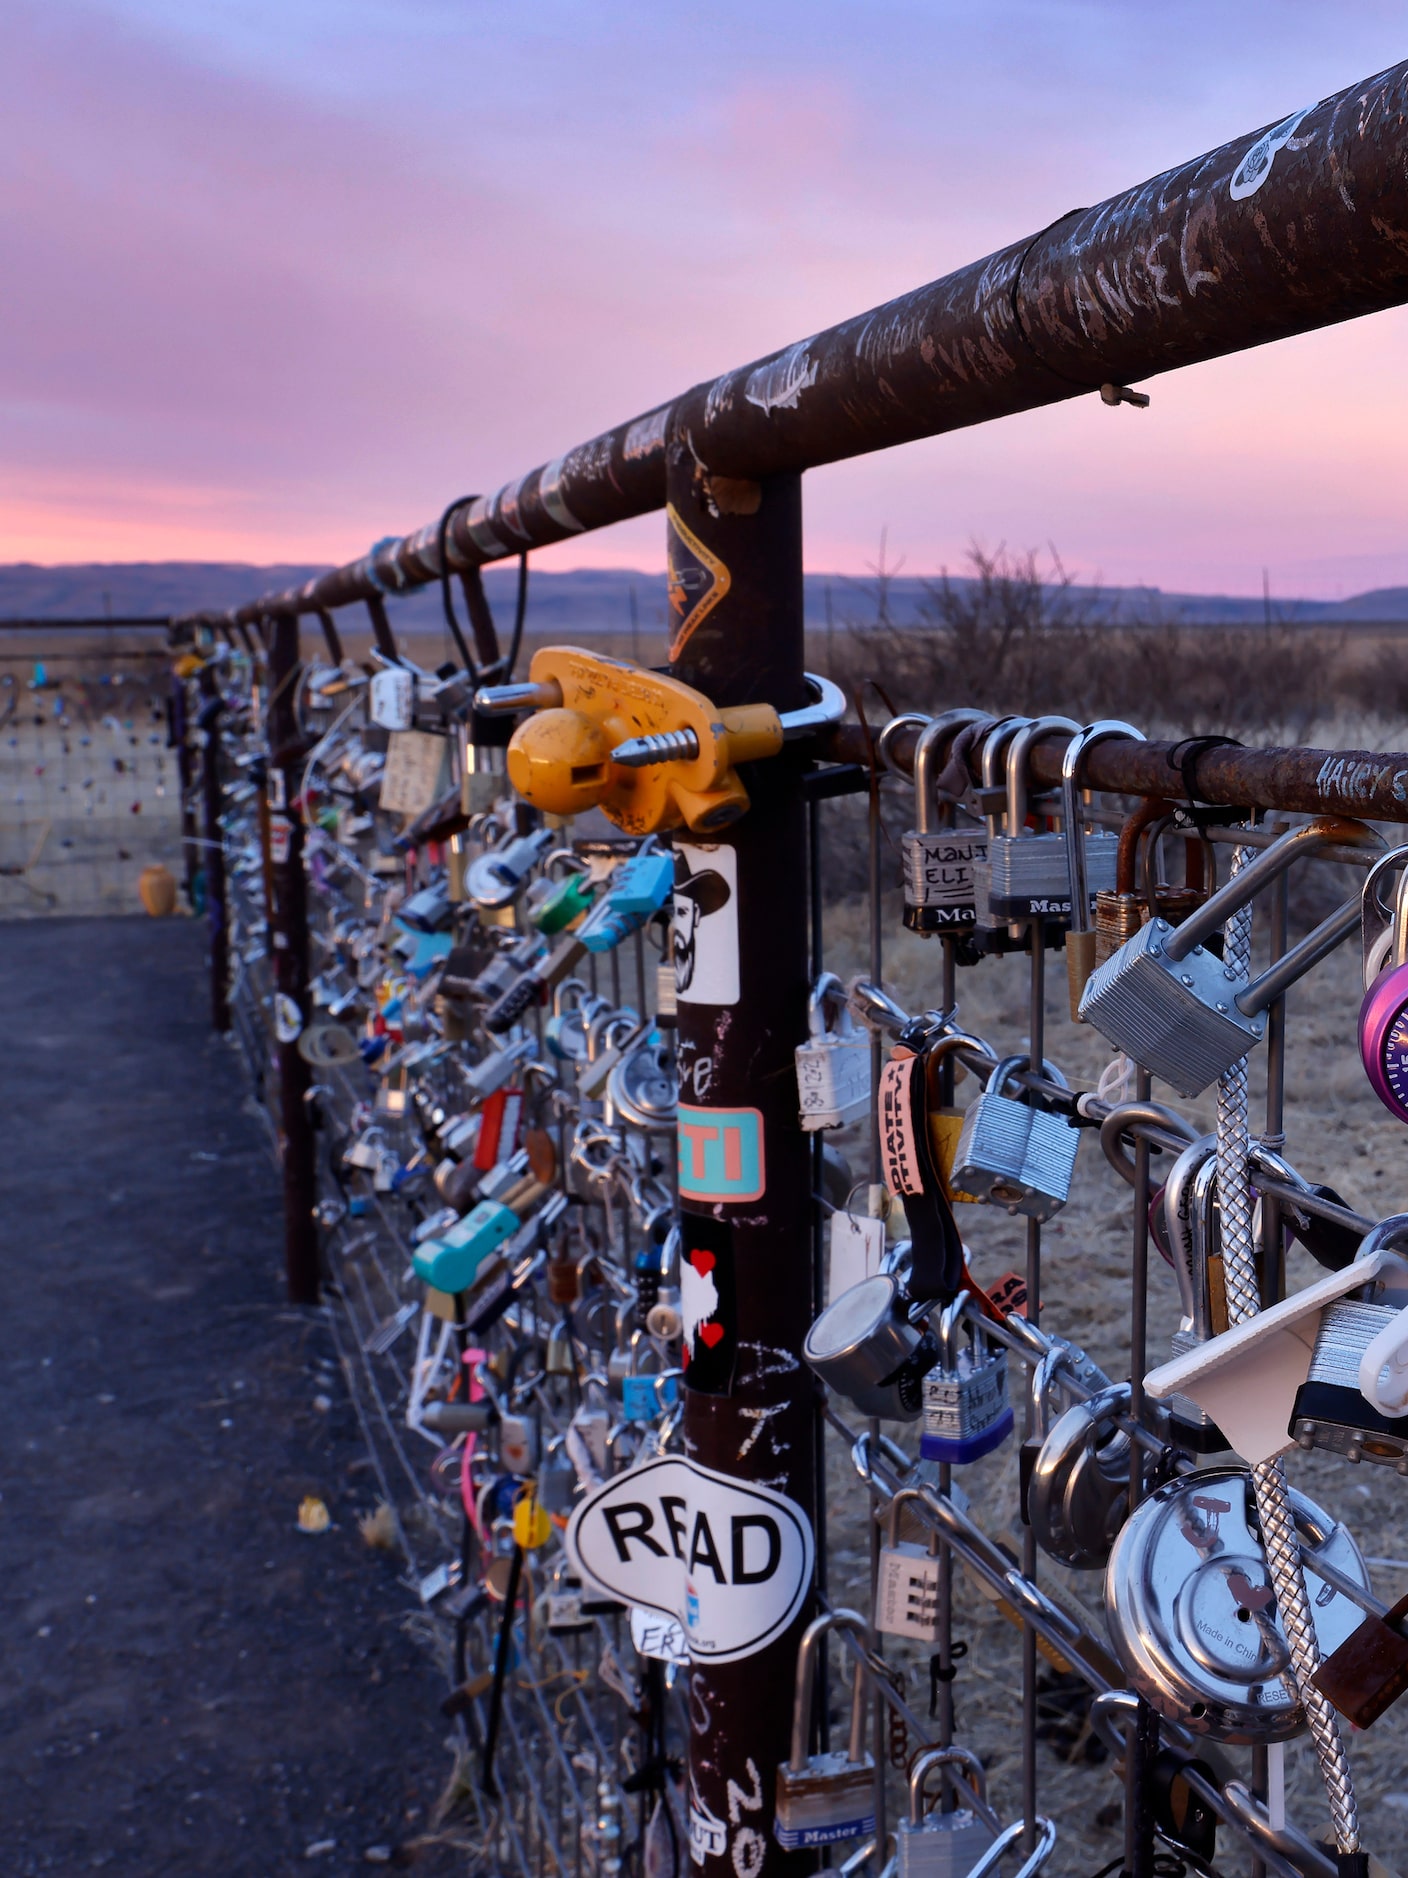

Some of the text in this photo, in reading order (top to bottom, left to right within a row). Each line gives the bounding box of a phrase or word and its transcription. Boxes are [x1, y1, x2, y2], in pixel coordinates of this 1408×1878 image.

[1029, 899, 1097, 913] Masr
[678, 1122, 743, 1181] TI
[884, 1090, 904, 1191] DIATE
[602, 1495, 782, 1587] READ
[1197, 1620, 1258, 1662] Made in Chin
[1257, 1689, 1288, 1704] RESE
[803, 1826, 859, 1843] Master
